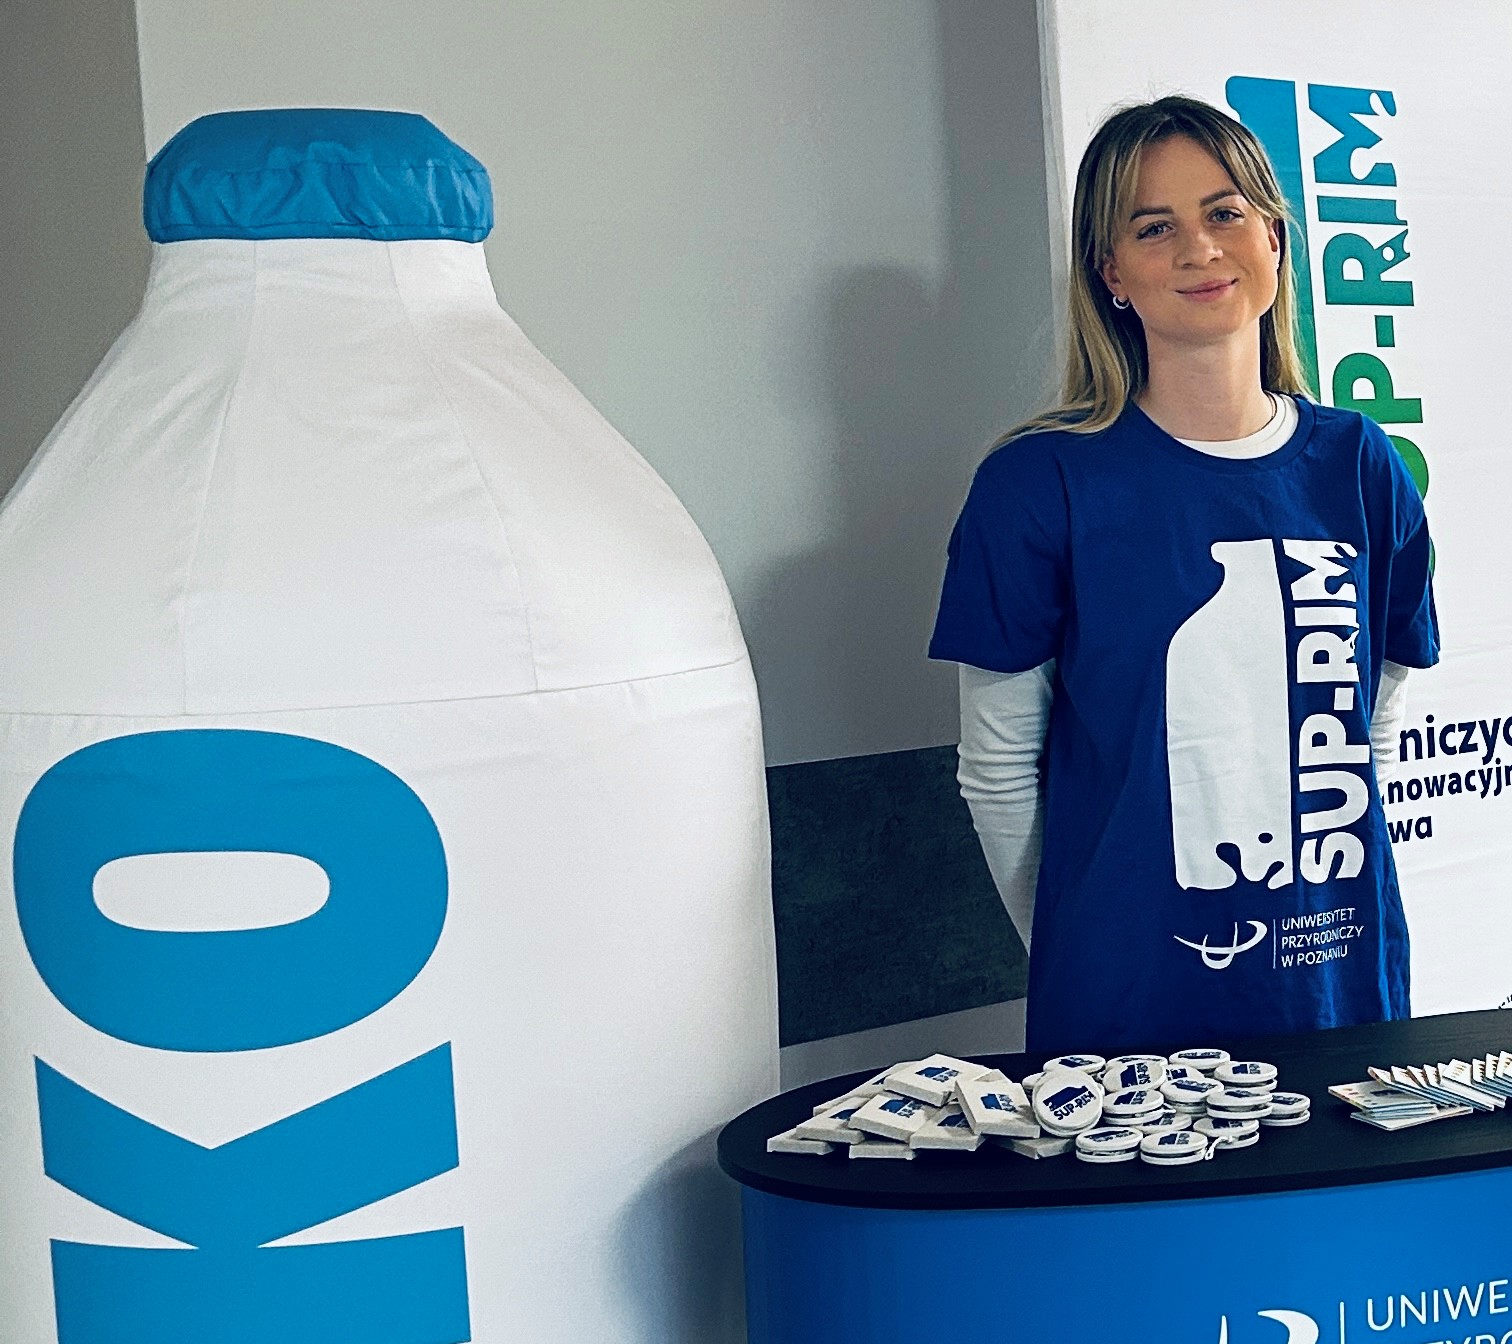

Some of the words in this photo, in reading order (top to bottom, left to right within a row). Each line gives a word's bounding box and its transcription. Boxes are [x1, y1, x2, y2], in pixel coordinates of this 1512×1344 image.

[1281, 538, 1370, 886] SUP-RIM
[1281, 953, 1294, 968] W
[1296, 943, 1348, 967] POZNANIU
